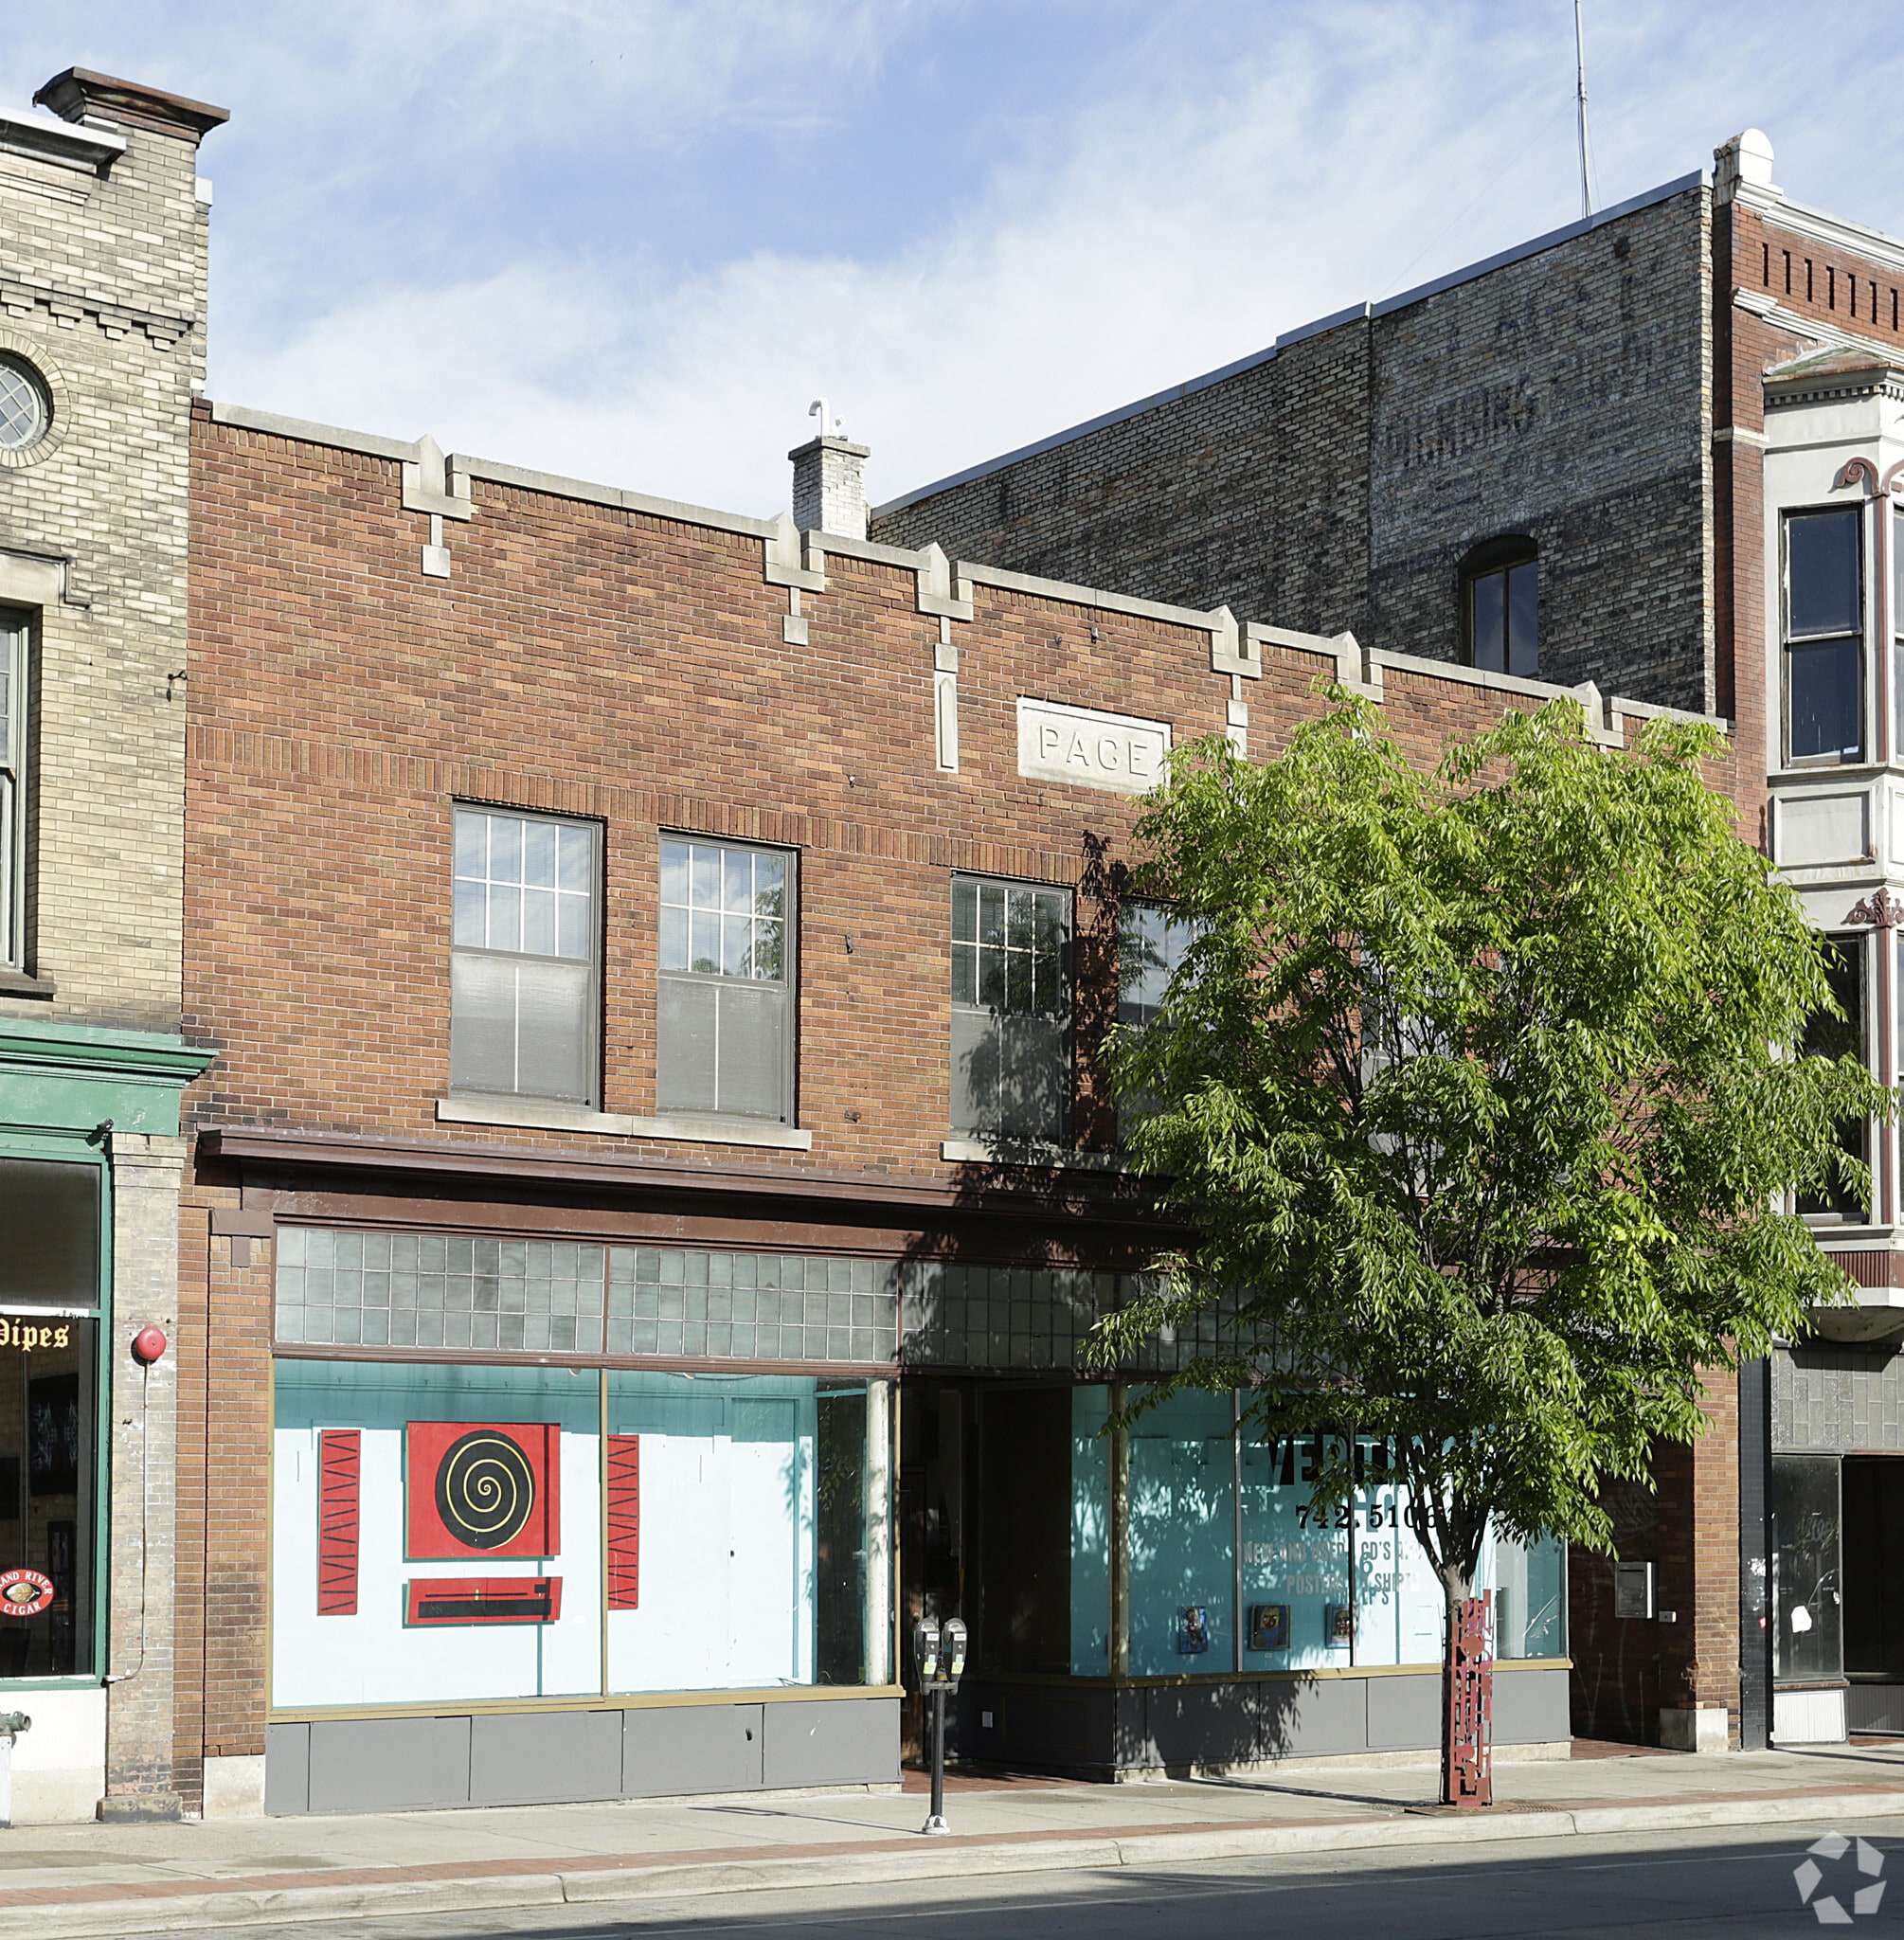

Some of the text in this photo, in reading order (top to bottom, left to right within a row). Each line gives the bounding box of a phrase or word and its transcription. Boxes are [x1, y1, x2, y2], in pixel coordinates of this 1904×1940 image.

[1039, 724, 1148, 777] PAGE
[1280, 1542, 1307, 1562] AND
[0, 1571, 53, 1595] AND RIVER
[1286, 1573, 1346, 1594] POSTERS
[3, 1601, 42, 1615] CIGAR
